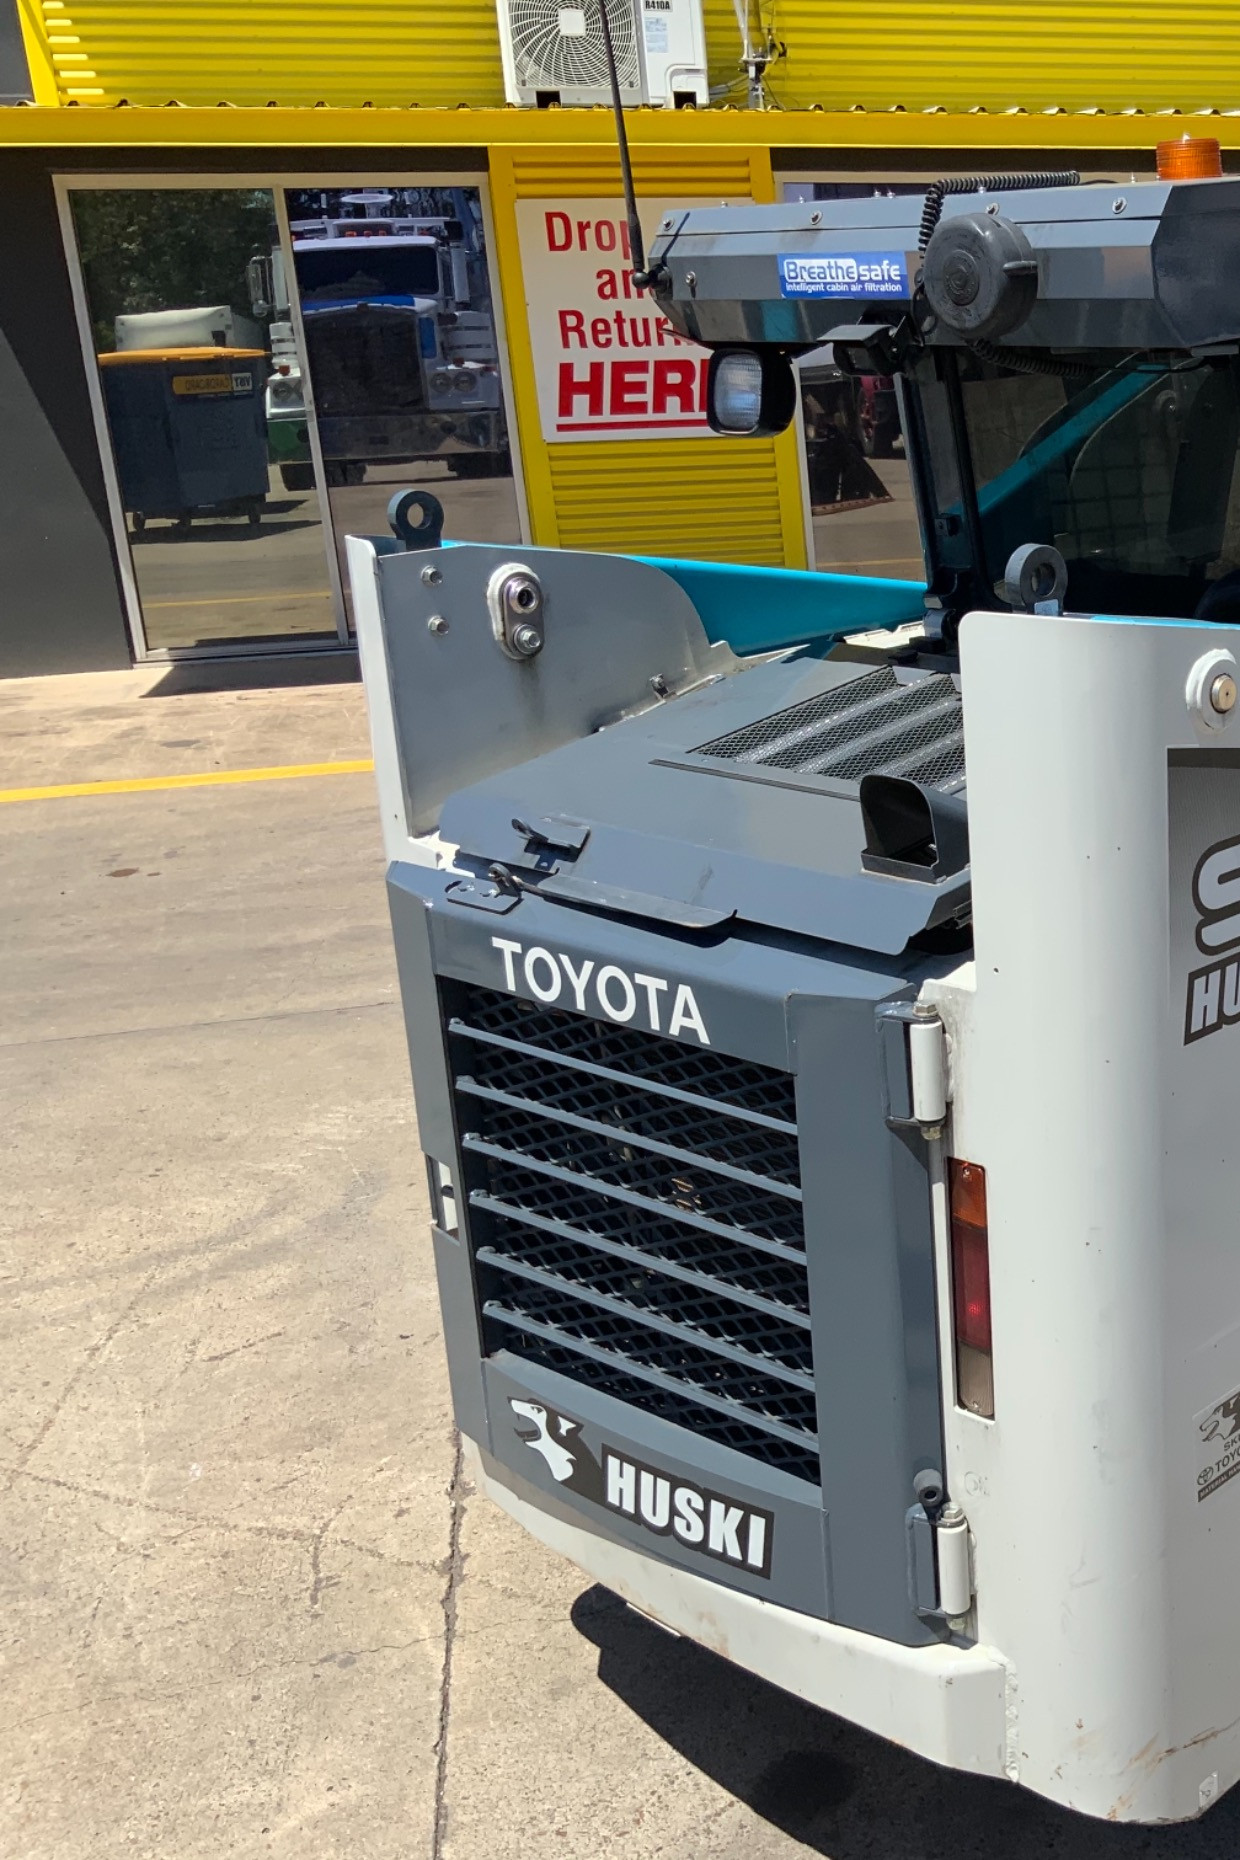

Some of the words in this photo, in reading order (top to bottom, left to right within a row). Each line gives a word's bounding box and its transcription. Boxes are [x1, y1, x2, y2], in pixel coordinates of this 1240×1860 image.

[786, 282, 825, 294] intelligent
[827, 282, 849, 292] cabin
[851, 282, 863, 292] air
[864, 282, 902, 292] filtration
[491, 936, 711, 1046] TOYOTA
[606, 1454, 767, 1569] HUSKI
